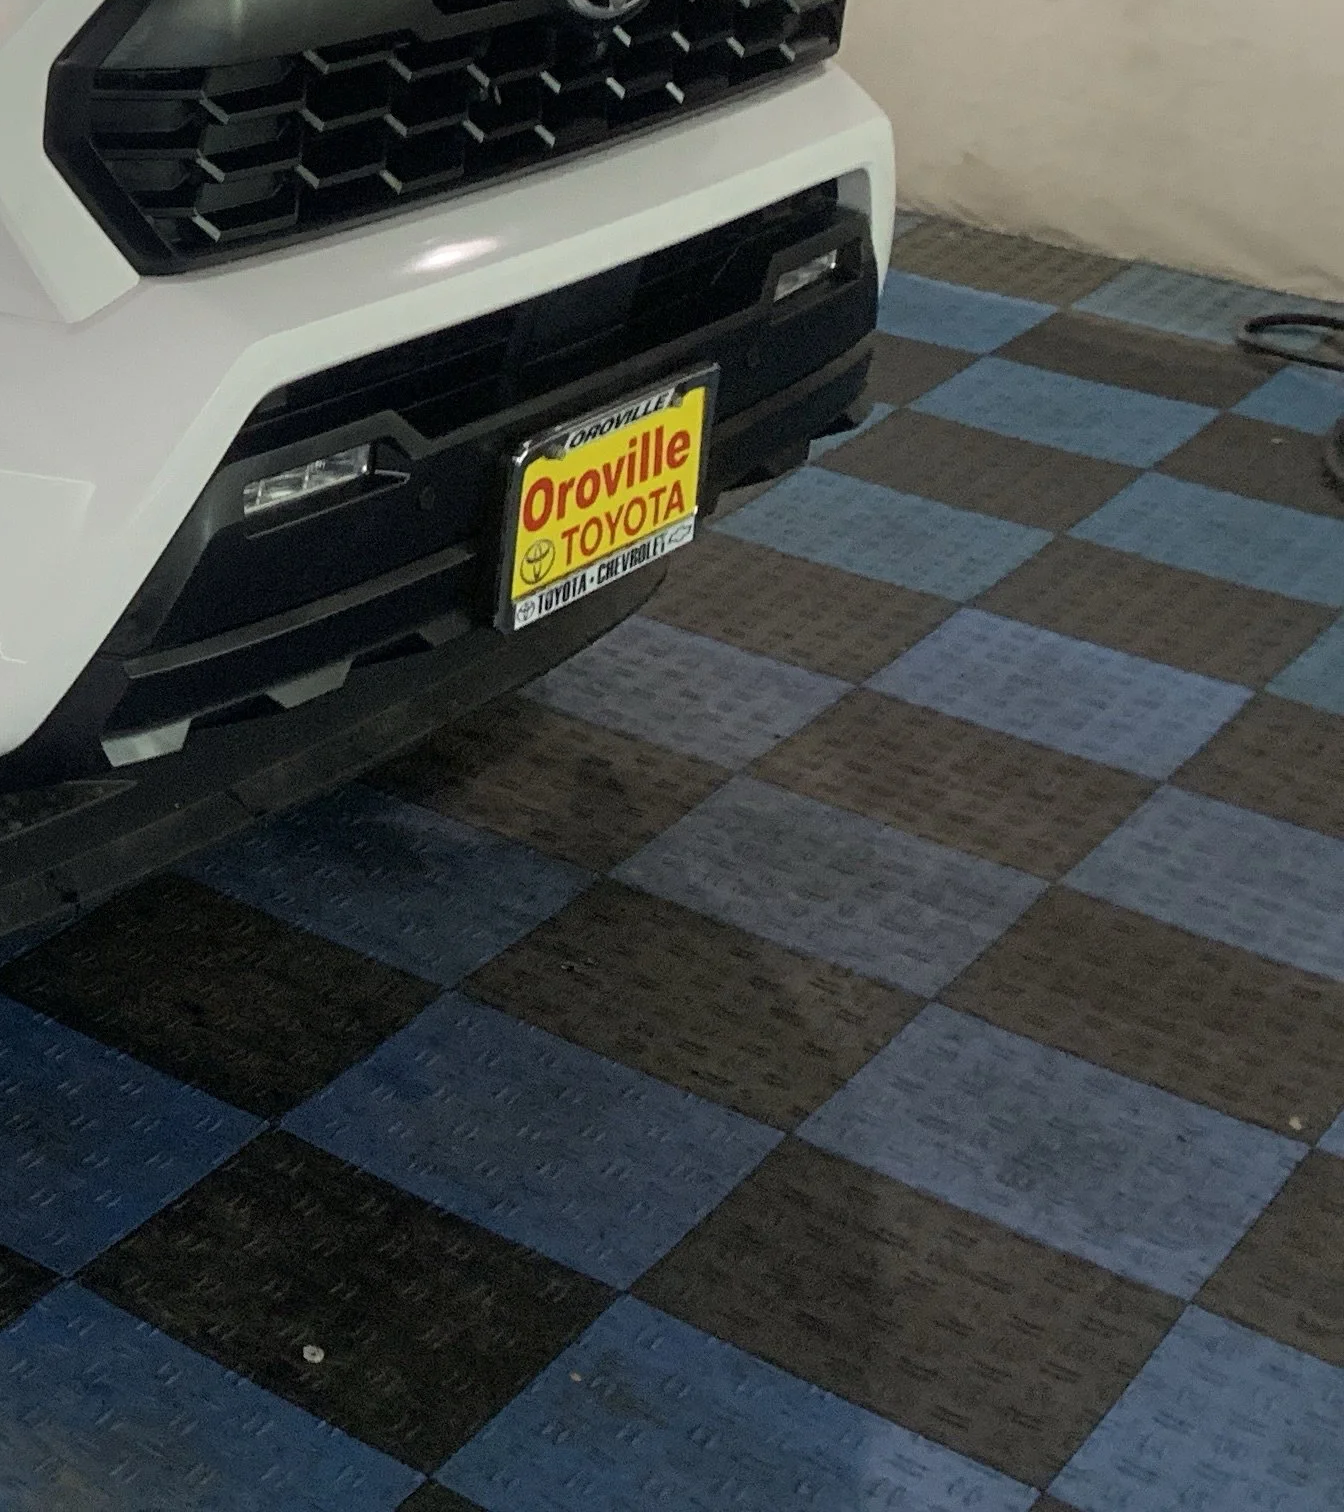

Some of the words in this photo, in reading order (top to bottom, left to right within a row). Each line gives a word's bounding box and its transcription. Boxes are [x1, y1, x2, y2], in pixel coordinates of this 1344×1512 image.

[570, 393, 670, 449] OROVILLE
[521, 424, 692, 533] Oroville
[560, 478, 686, 567] TOYOTA
[536, 574, 587, 615] TOYOTA
[596, 533, 667, 585] CHEVROLET
